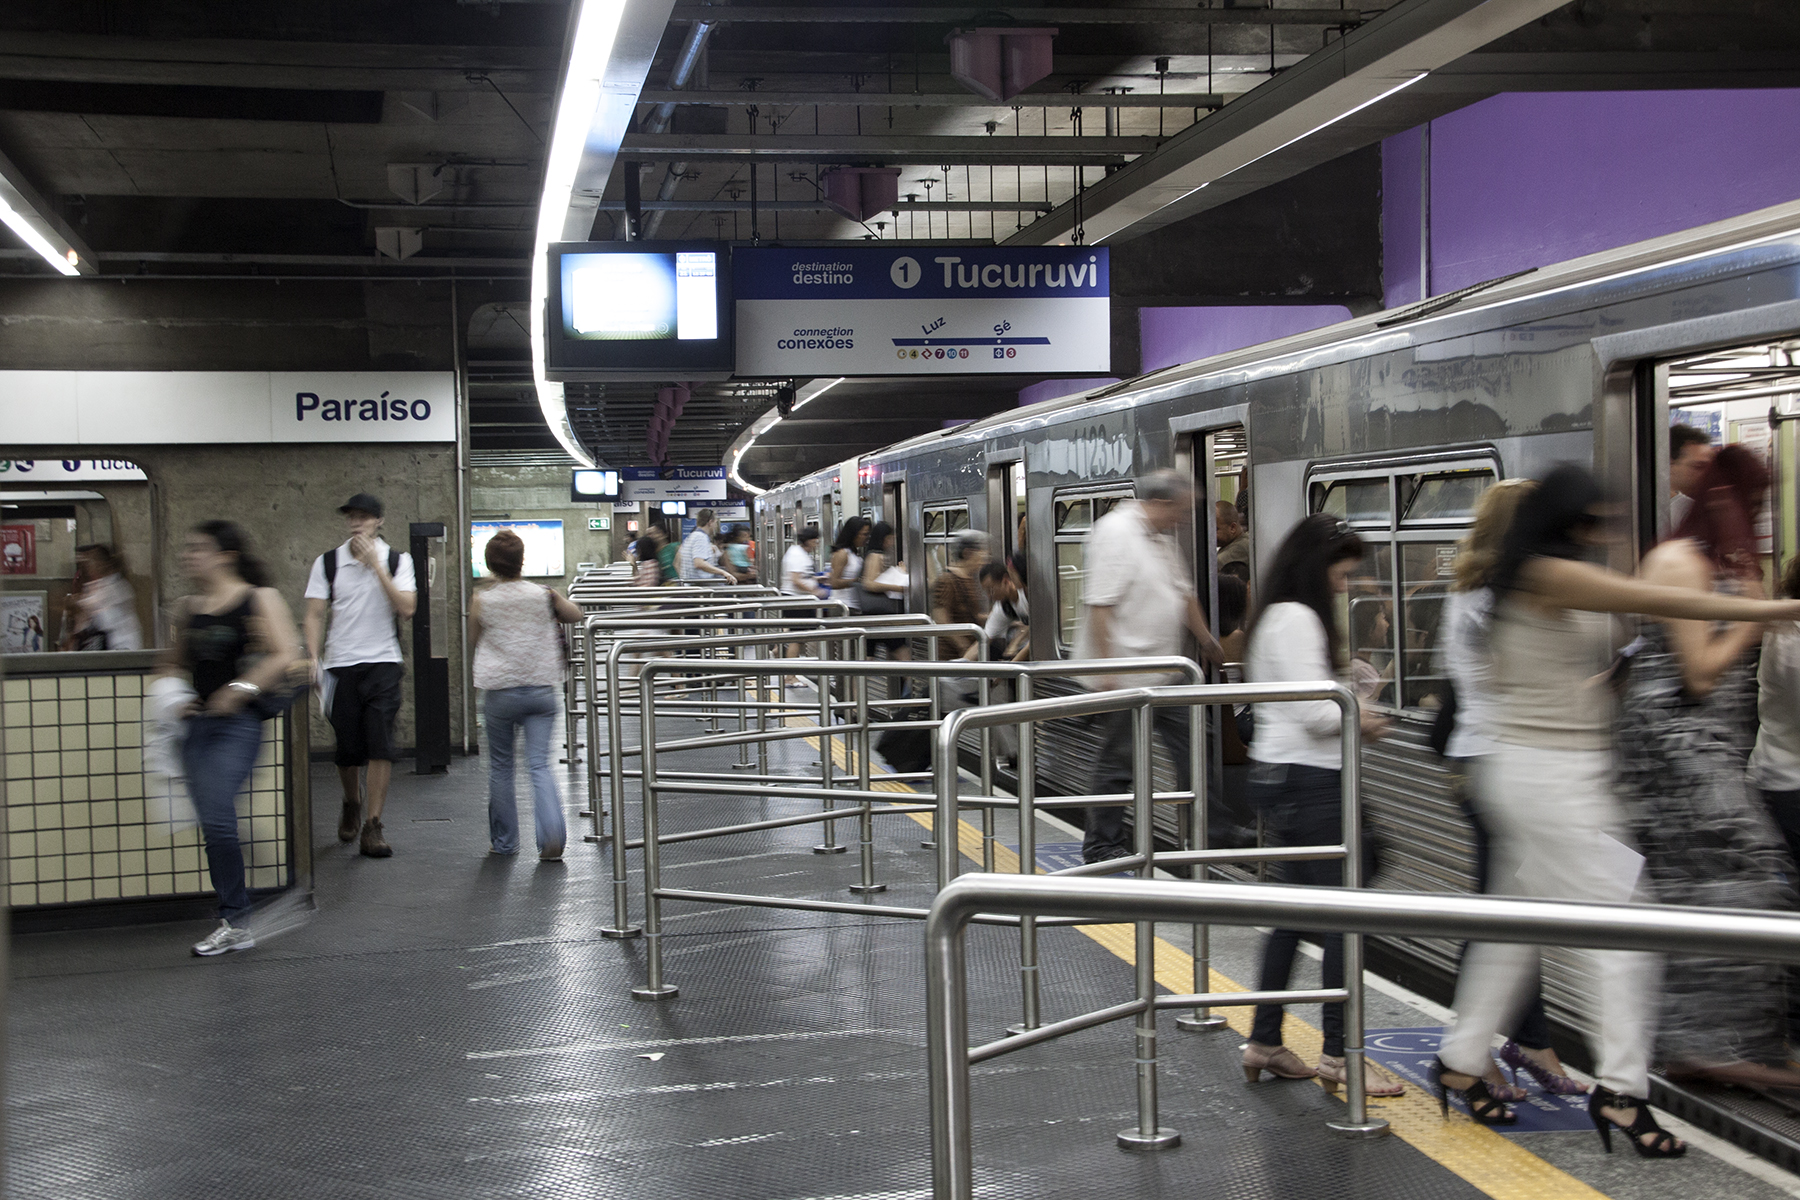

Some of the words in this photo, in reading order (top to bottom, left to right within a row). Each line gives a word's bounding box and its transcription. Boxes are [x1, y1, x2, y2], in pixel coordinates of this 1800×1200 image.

[791, 262, 853, 272] destination
[934, 255, 1097, 288] Tucuruvi
[793, 271, 854, 284] destino
[793, 327, 854, 337] connection
[921, 317, 947, 335] Luz
[993, 319, 1012, 336] Sé
[777, 336, 854, 350] conexões
[296, 391, 431, 421] Paraíso
[676, 468, 723, 478] Tucuruvi
